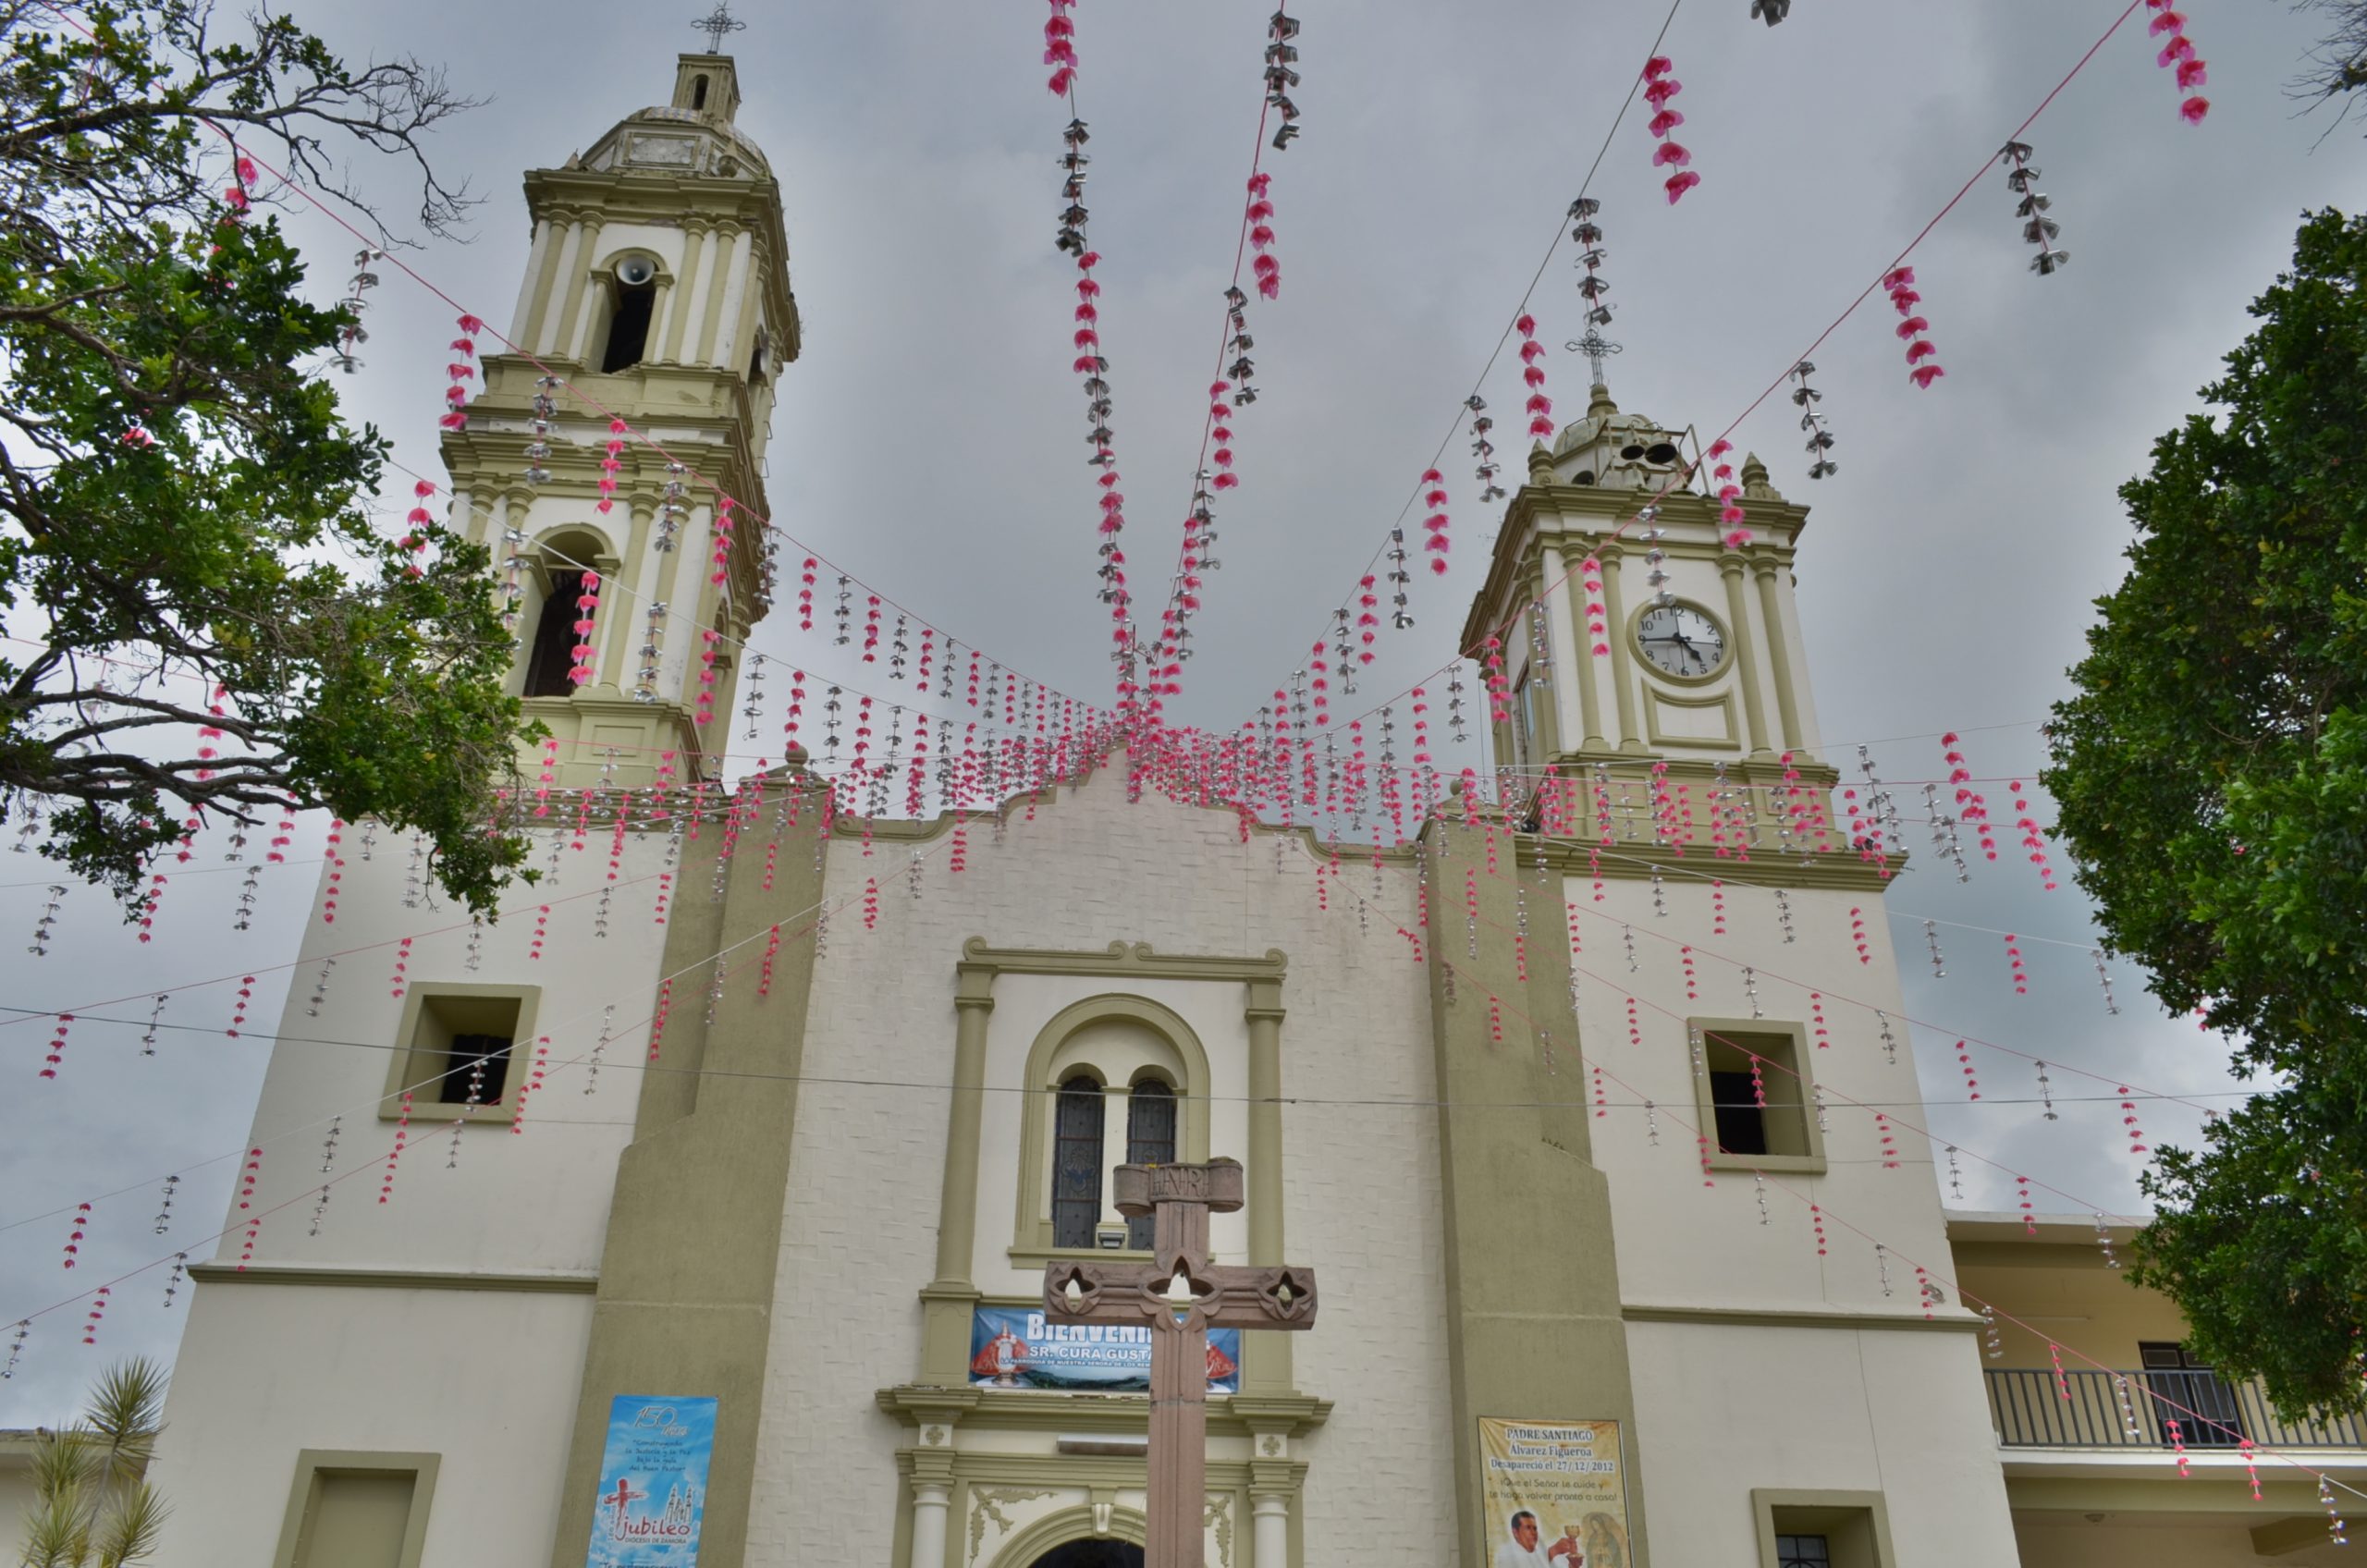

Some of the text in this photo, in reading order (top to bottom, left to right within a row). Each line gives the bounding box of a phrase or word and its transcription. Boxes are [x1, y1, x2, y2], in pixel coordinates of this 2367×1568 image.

[1651, 610, 1662, 620] 11
[1669, 606, 1685, 618] 12
[1695, 613, 1700, 624] 1
[1640, 620, 1654, 631] 10
[1707, 625, 1716, 635] 2
[1637, 634, 1646, 645] 9
[1714, 638, 1723, 649] 3
[1646, 650, 1655, 661] 8
[1711, 652, 1720, 664] 4
[1662, 662, 1670, 670] 7
[1681, 666, 1690, 677] 6
[1699, 663, 1708, 674] 5
[1030, 1346, 1053, 1357] SR.
[1059, 1349, 1101, 1359] CURA
[634, 1406, 677, 1428] 150
[1507, 1428, 1592, 1440] PADRE SANTIAGO
[1510, 1443, 1592, 1458] Álvarez Figueroa
[1491, 1459, 1543, 1471] Desapareció
[1534, 1479, 1559, 1488] Señor
[1554, 1493, 1583, 1501] pronto
[615, 1516, 690, 1541] jubileo
